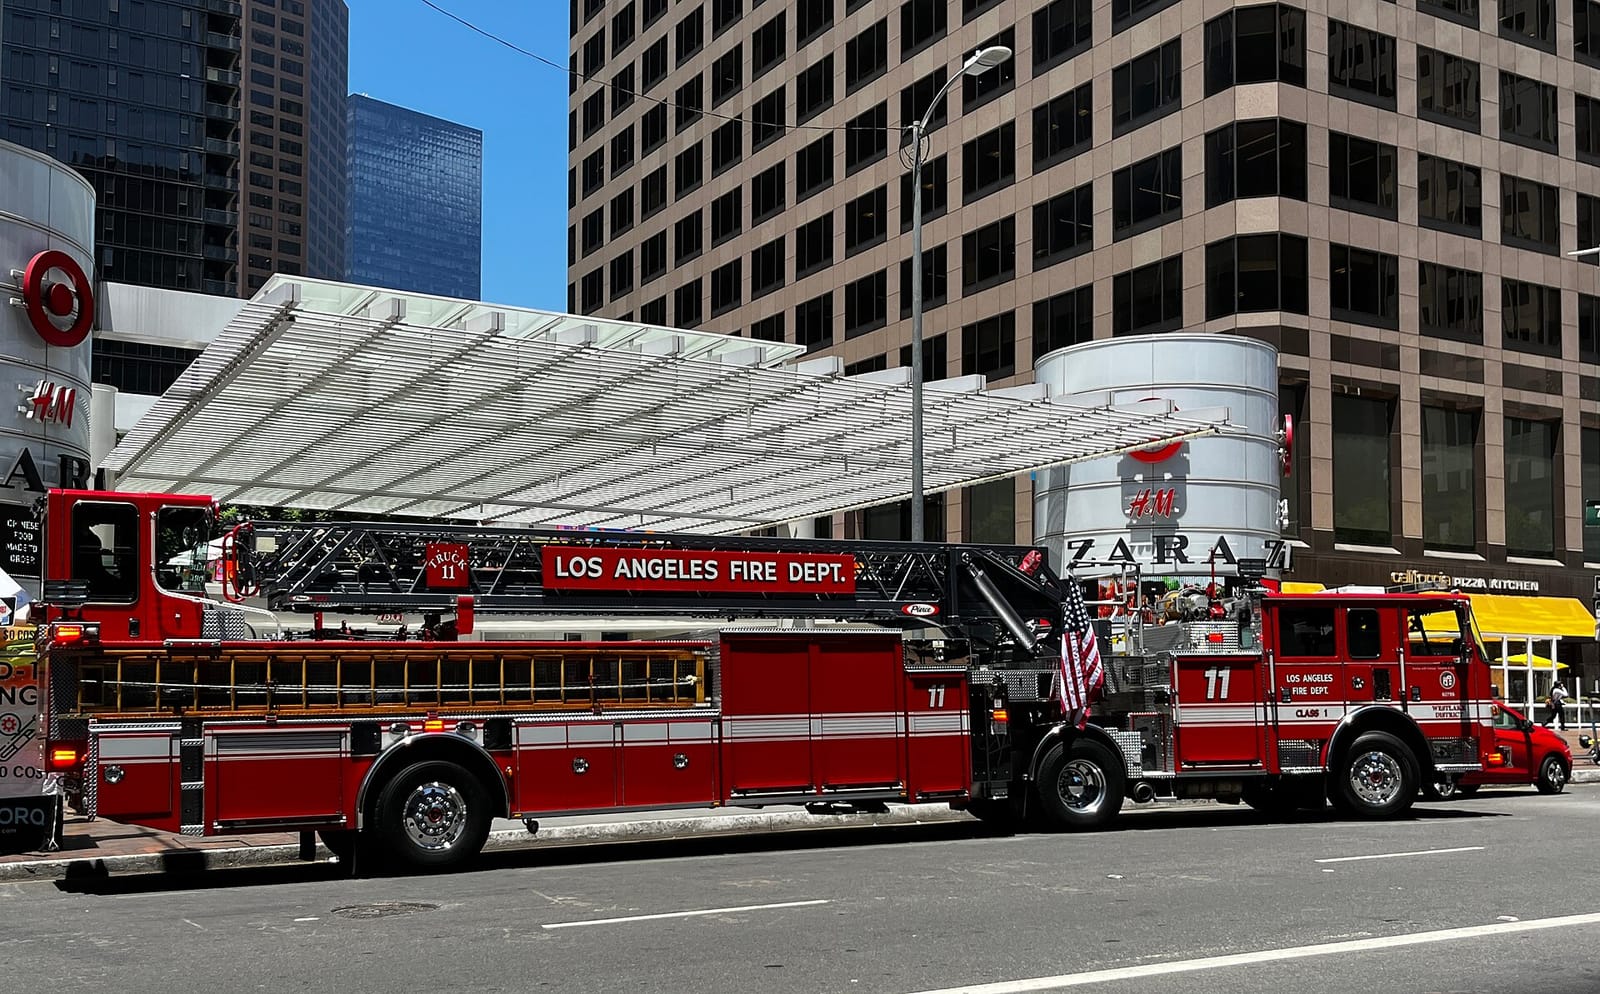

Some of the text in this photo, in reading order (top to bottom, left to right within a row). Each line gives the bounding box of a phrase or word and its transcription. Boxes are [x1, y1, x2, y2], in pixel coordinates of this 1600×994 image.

[28, 380, 76, 429] H&M
[1130, 488, 1175, 519] H&M
[1067, 535, 1239, 567] ZARA
[428, 551, 468, 571] TRUCK
[441, 565, 456, 580] 11
[556, 556, 847, 583] LOS ANGELES FIRE DEPT.
[1453, 577, 1487, 589] PIZZA
[1489, 579, 1539, 591] KITCHEN
[911, 605, 931, 614] Pierce
[17, 629, 36, 641] COS
[1204, 666, 1231, 699] 11
[1286, 674, 1333, 683] LOS ANGELES
[928, 685, 945, 708] 11
[1292, 687, 1329, 695] FIRE DEPT.
[1296, 709, 1319, 718] CLASS
[13, 765, 44, 779] COS
